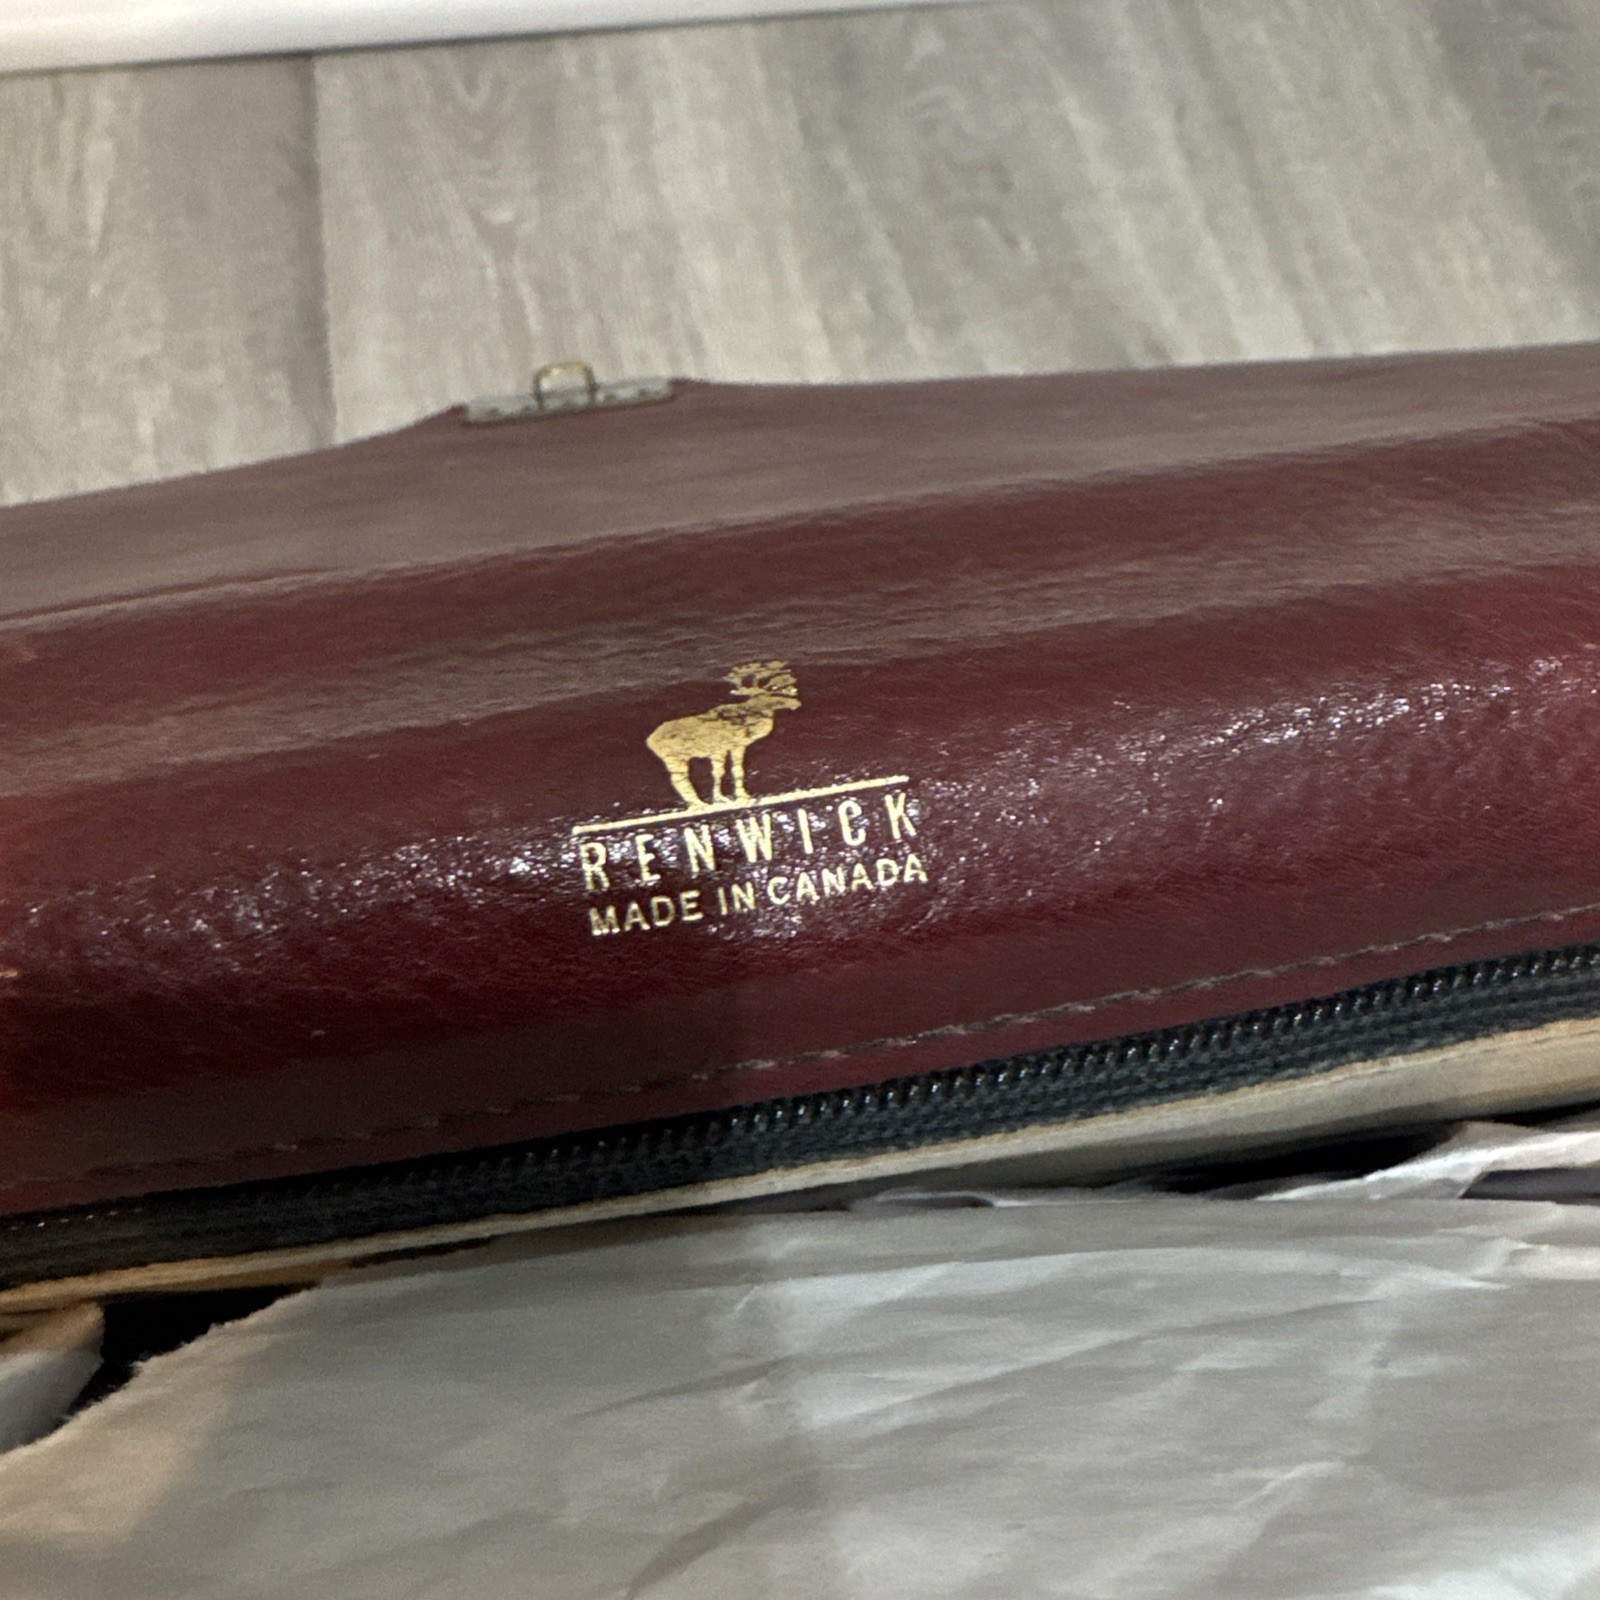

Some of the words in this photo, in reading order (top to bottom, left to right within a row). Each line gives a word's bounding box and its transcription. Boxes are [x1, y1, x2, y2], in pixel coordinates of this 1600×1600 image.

[579, 792, 917, 892] RENWICK
[588, 890, 704, 936] MADE
[717, 881, 757, 915] IN
[767, 853, 929, 905] CANADA
